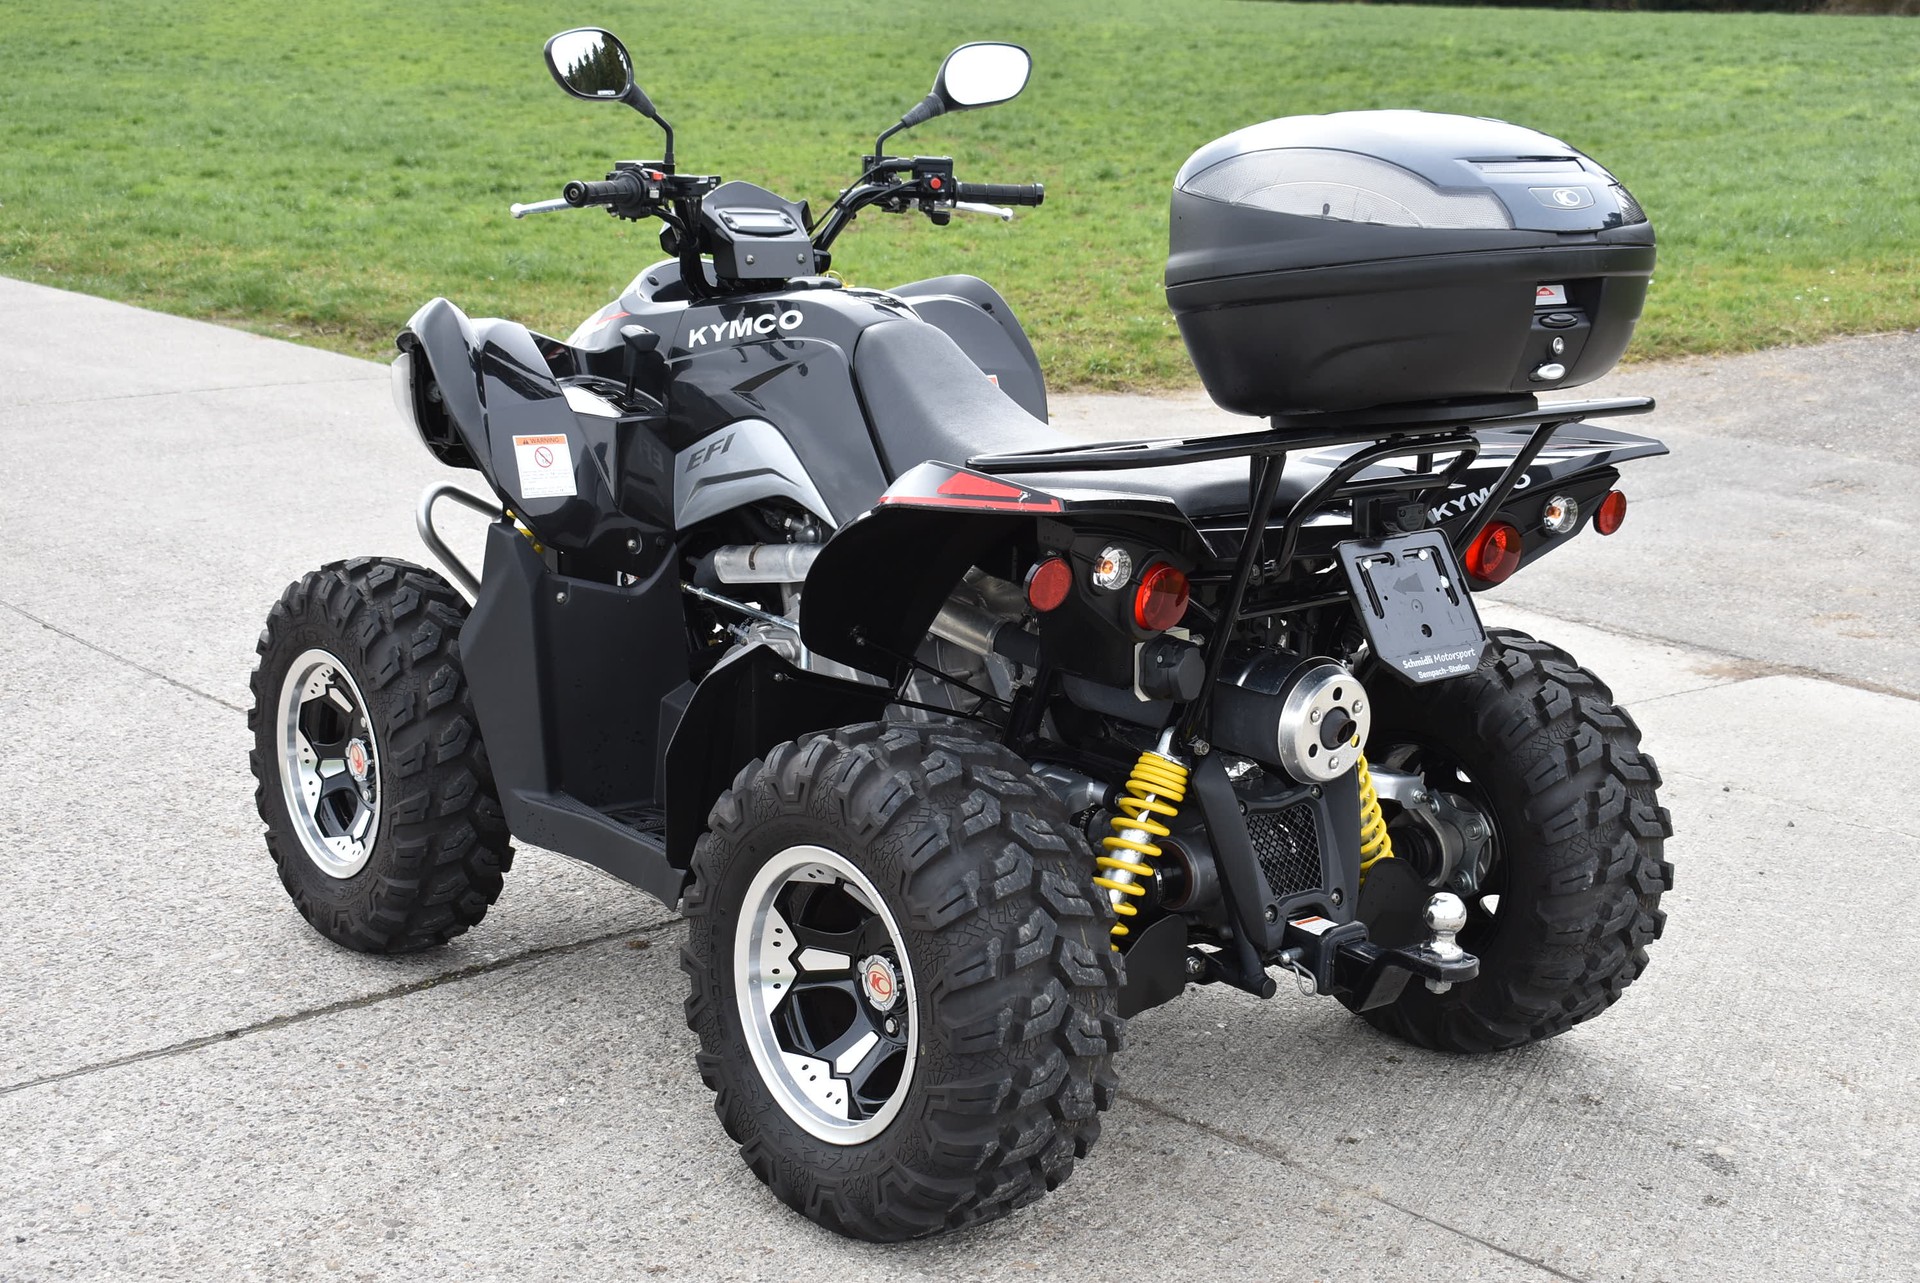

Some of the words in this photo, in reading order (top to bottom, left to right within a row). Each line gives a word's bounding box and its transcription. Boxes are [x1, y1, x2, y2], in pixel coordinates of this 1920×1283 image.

[688, 309, 804, 348] KYMCO
[685, 432, 736, 473] EFI
[1431, 474, 1531, 522] KYMO
[1417, 663, 1471, 679] Sempach-Station
[1433, 648, 1476, 663] Motorsport
